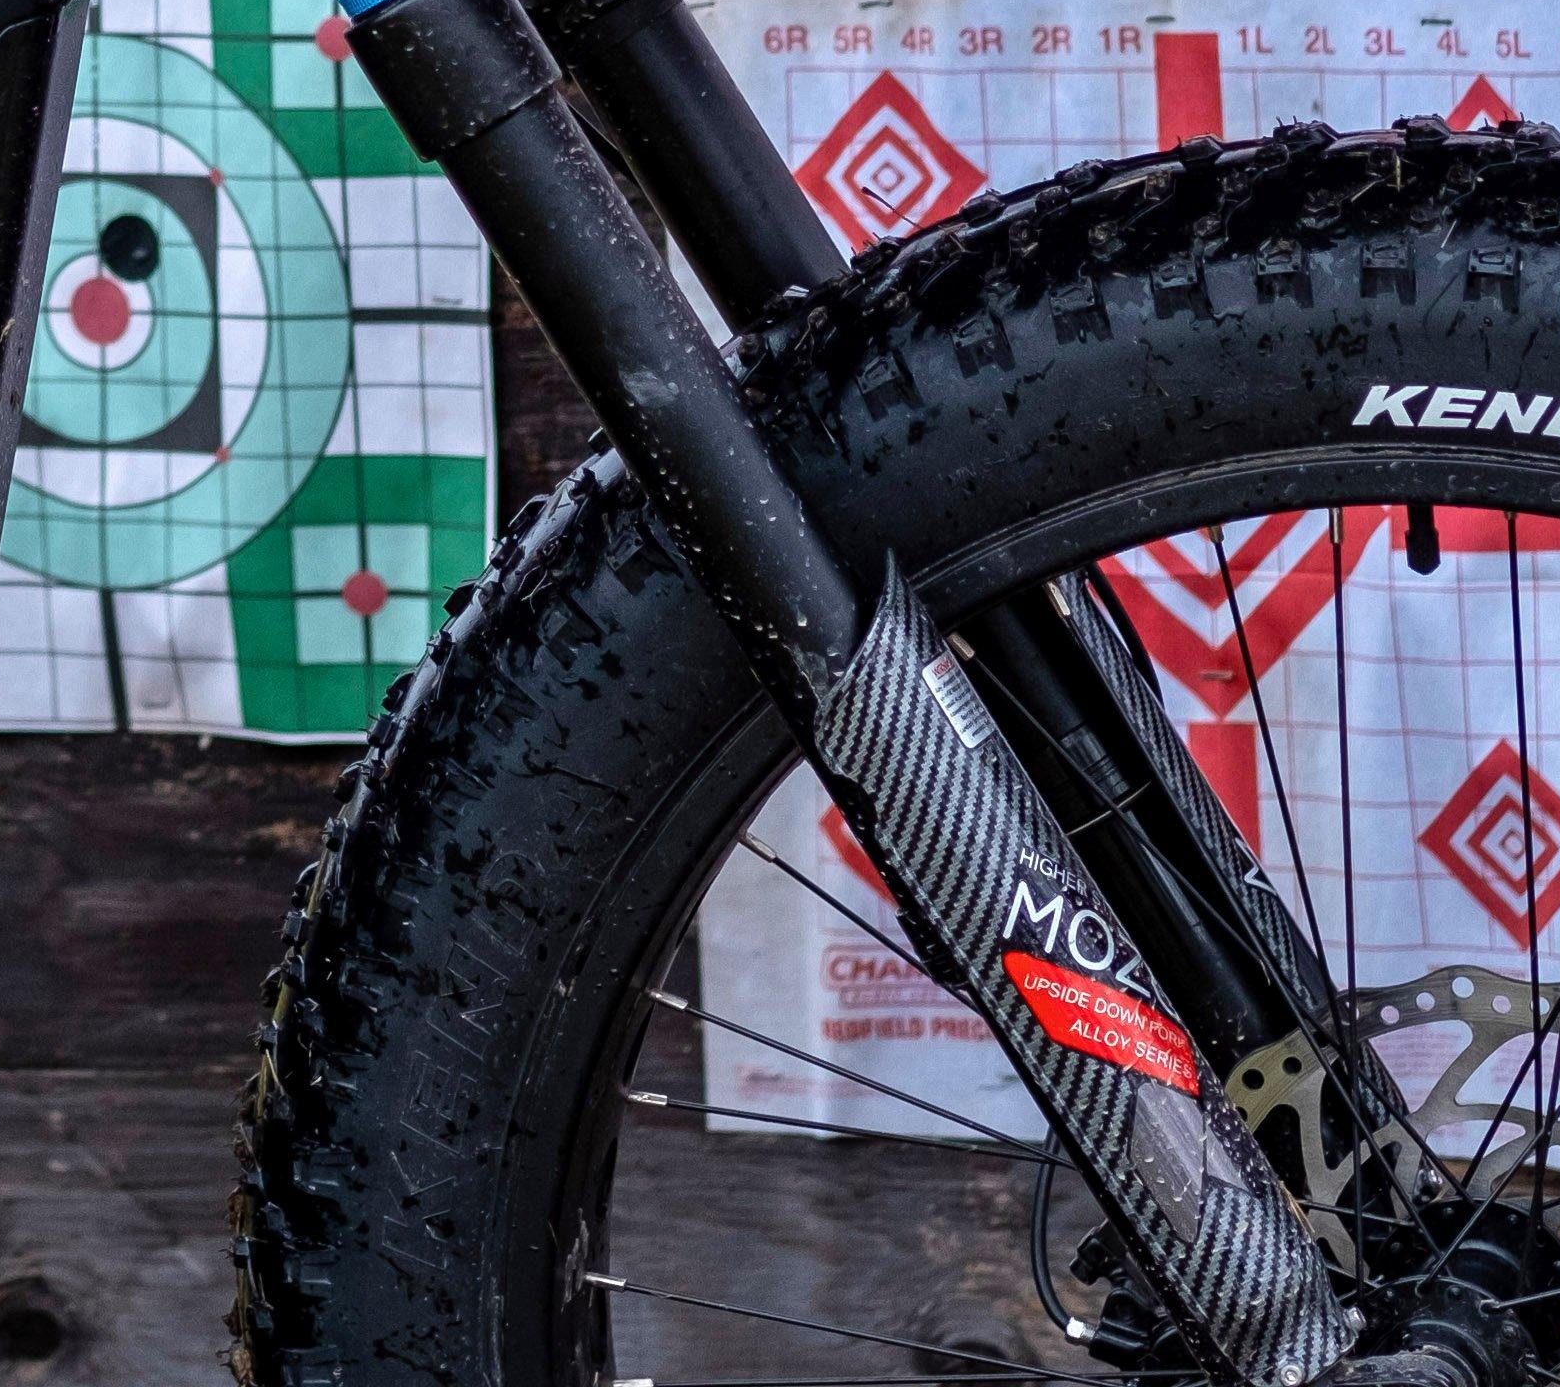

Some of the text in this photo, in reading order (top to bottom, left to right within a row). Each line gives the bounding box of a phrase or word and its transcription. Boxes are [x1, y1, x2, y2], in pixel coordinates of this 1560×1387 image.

[764, 24, 808, 53] 6R
[834, 25, 873, 54] 5R
[900, 26, 932, 51] 4R
[959, 27, 1003, 56] 3R
[1031, 25, 1070, 55] 2R
[1099, 26, 1141, 53] 1R
[1237, 27, 1273, 54] 1L
[1304, 26, 1334, 55] 2L
[1365, 28, 1405, 55] 3L
[1437, 29, 1468, 58] 4L
[1496, 30, 1531, 58] 5L
[1019, 847, 1088, 895] HIGHER
[1024, 973, 1186, 1049] UPSIDE DOWN FORK
[1070, 1019, 1193, 1079] ALLOY SERIES
